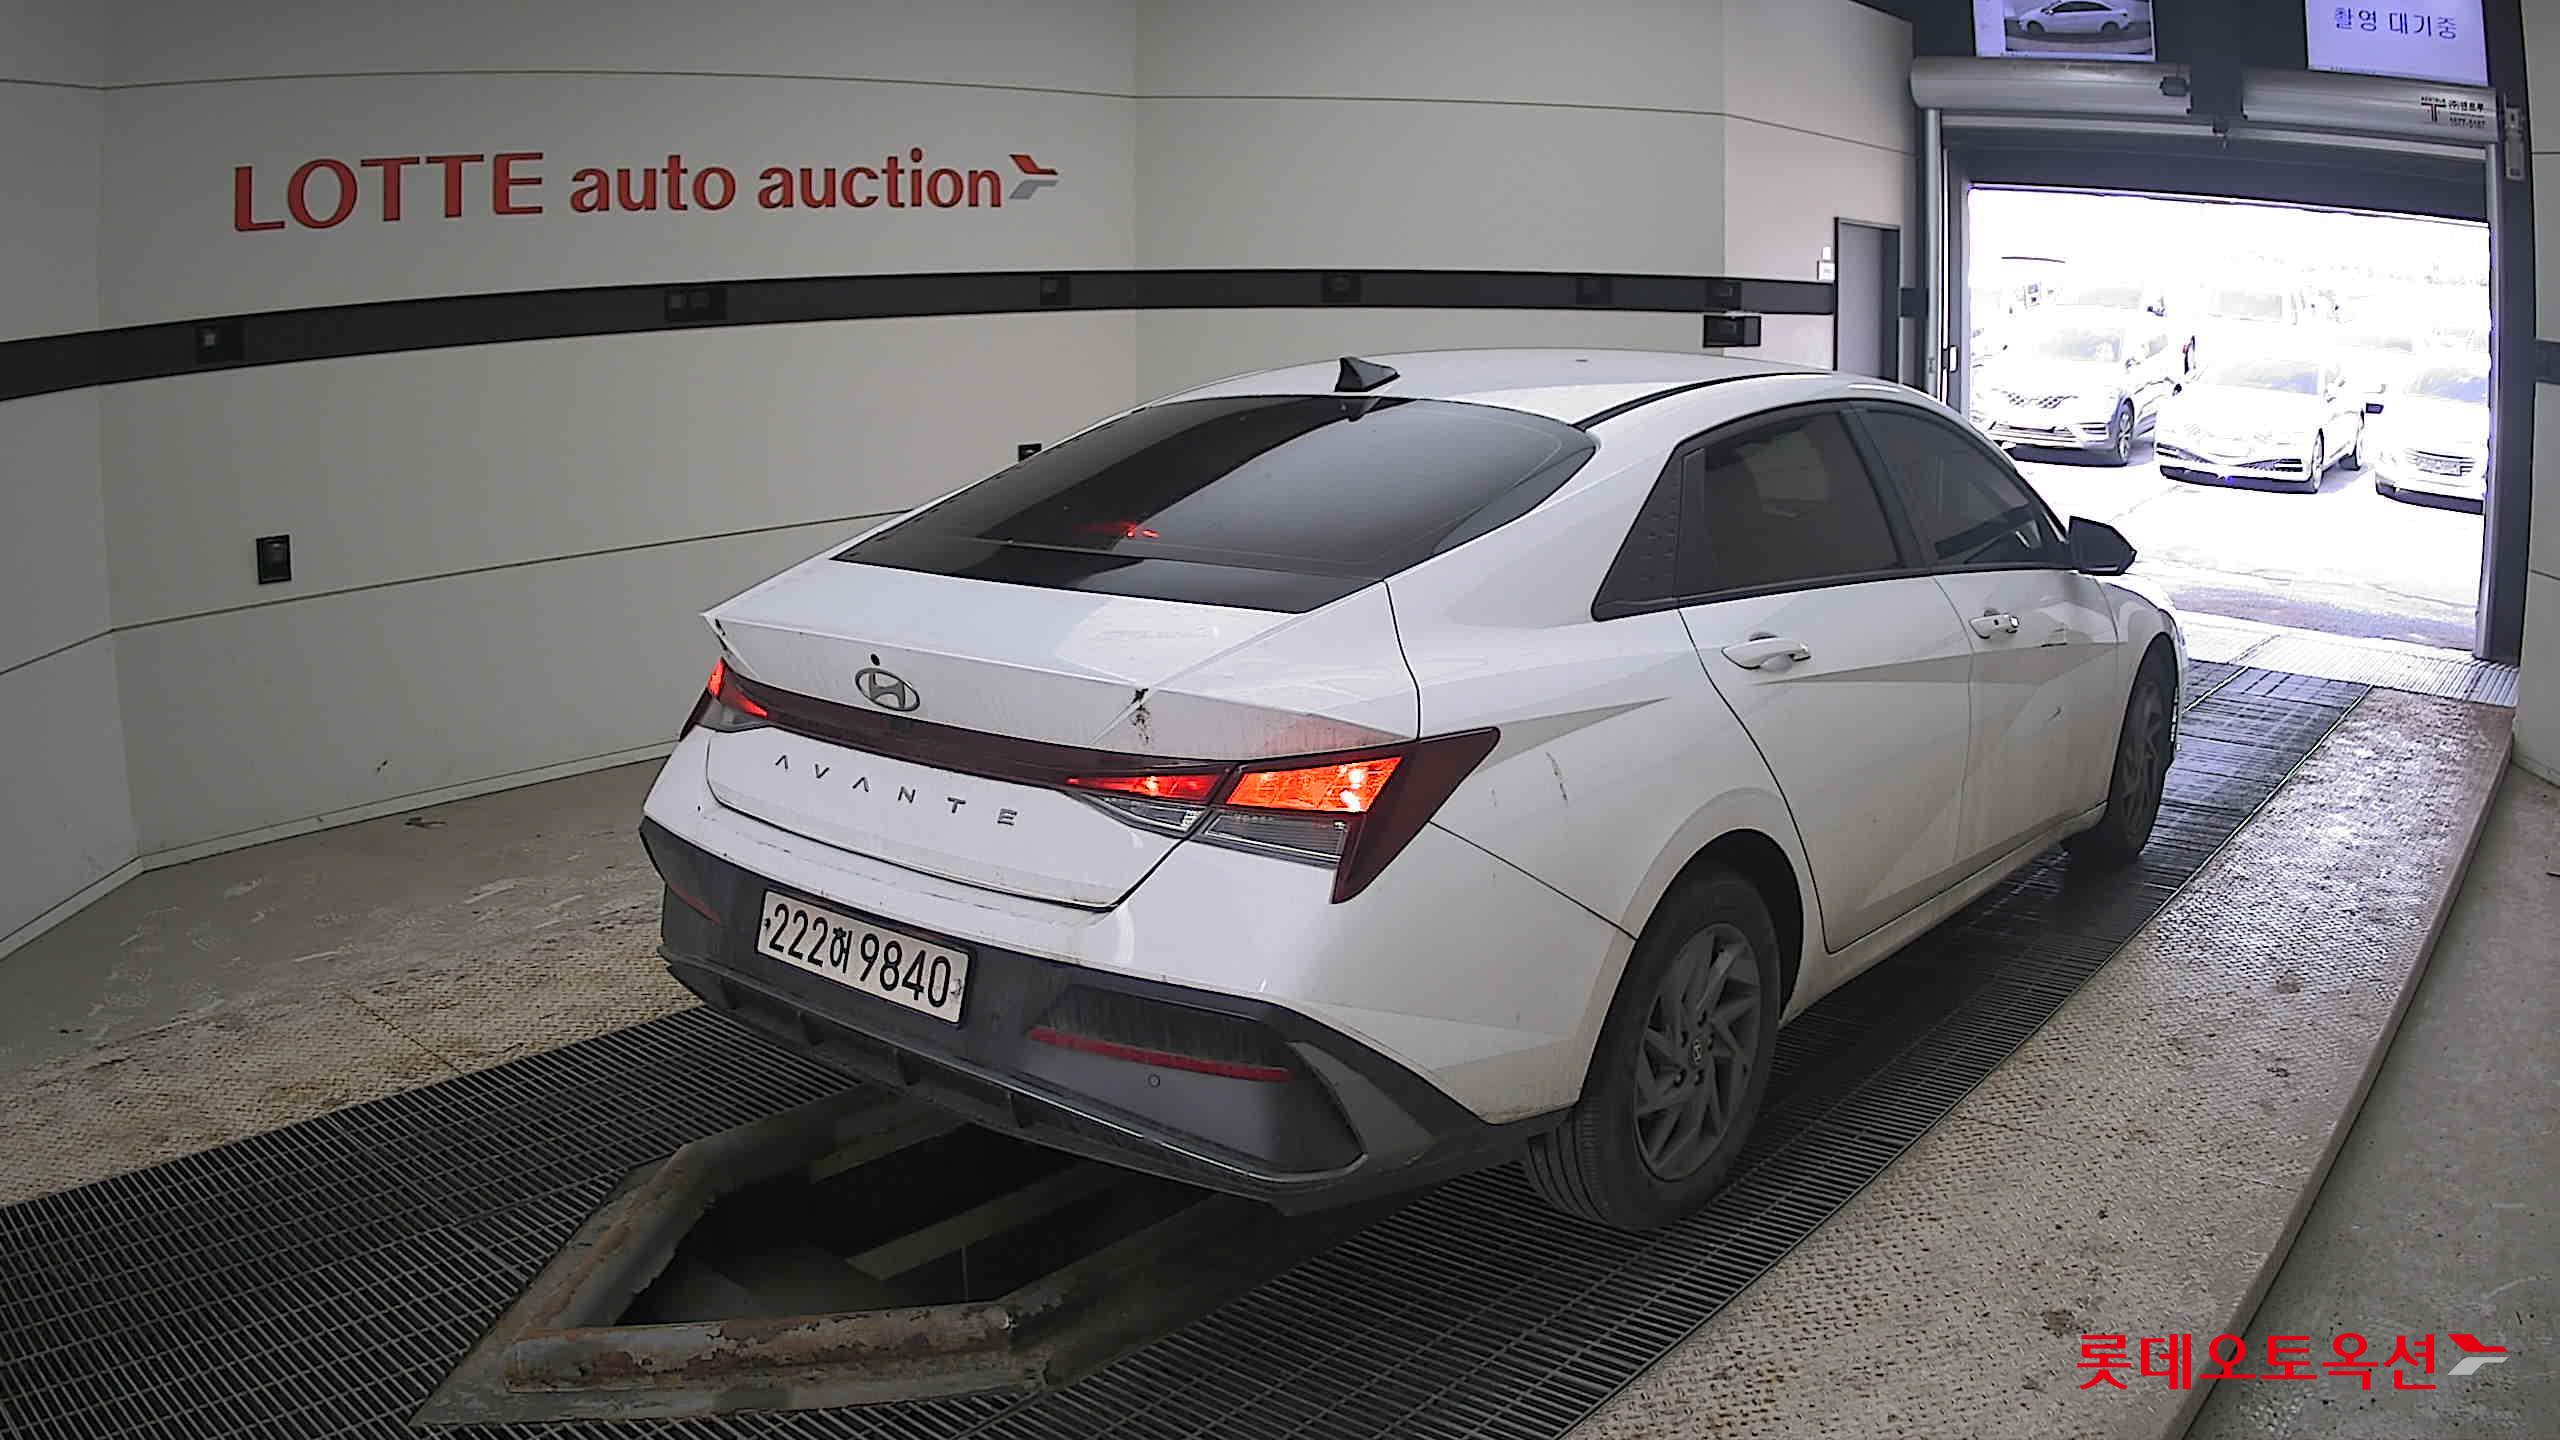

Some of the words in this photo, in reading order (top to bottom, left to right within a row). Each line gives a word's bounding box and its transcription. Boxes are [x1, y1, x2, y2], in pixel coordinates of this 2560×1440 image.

[2335, 7, 2377, 32] 촬영
[2389, 12, 2457, 40] 대기중
[234, 152, 544, 232] LOTTE
[569, 153, 737, 213] auto
[758, 147, 1003, 209] auction
[774, 754, 1018, 826] AVANTE
